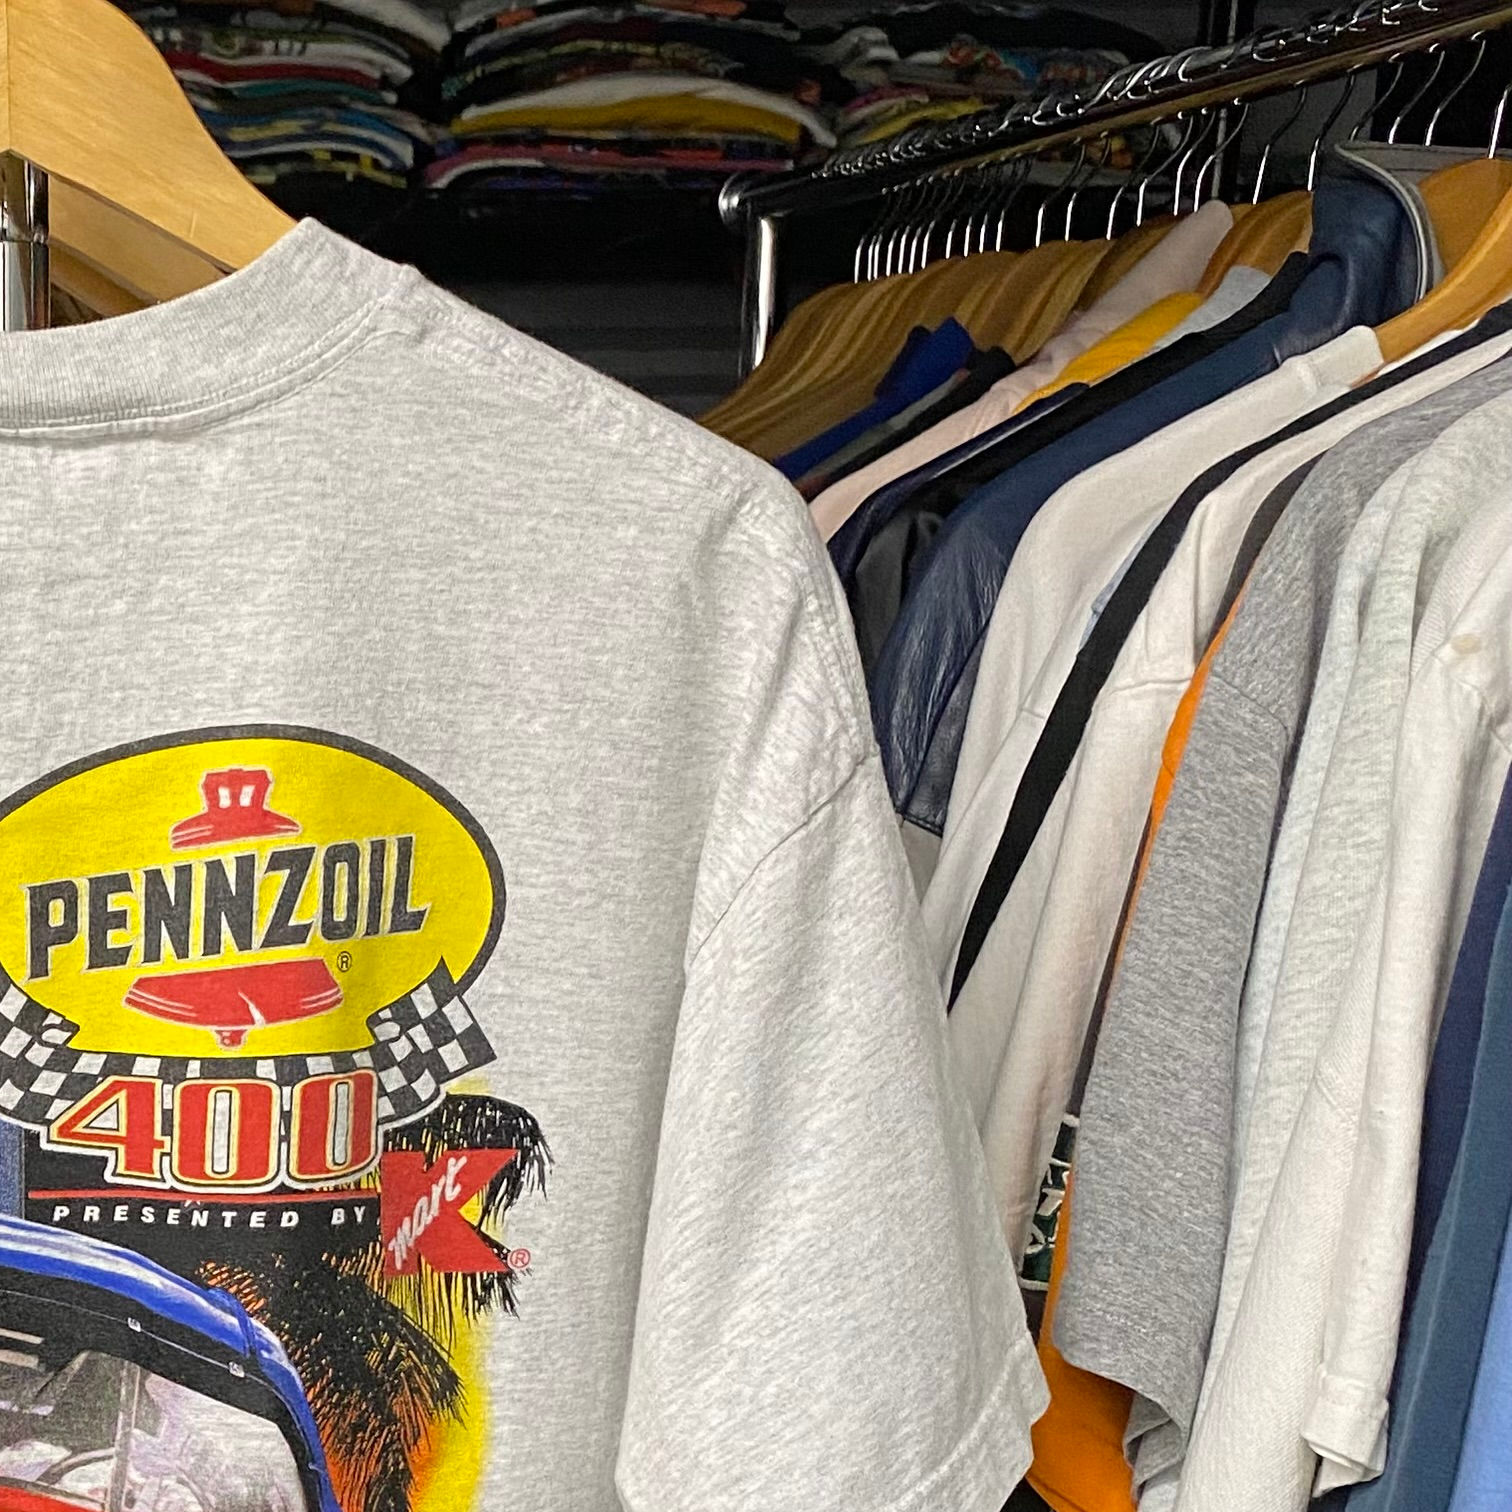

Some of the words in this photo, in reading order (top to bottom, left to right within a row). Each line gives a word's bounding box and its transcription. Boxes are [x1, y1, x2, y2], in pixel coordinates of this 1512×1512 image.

[25, 836, 429, 983] PENNZOIL
[46, 1069, 382, 1192] 400
[53, 1204, 299, 1229] PRESENTED
[330, 1205, 367, 1227] BY
